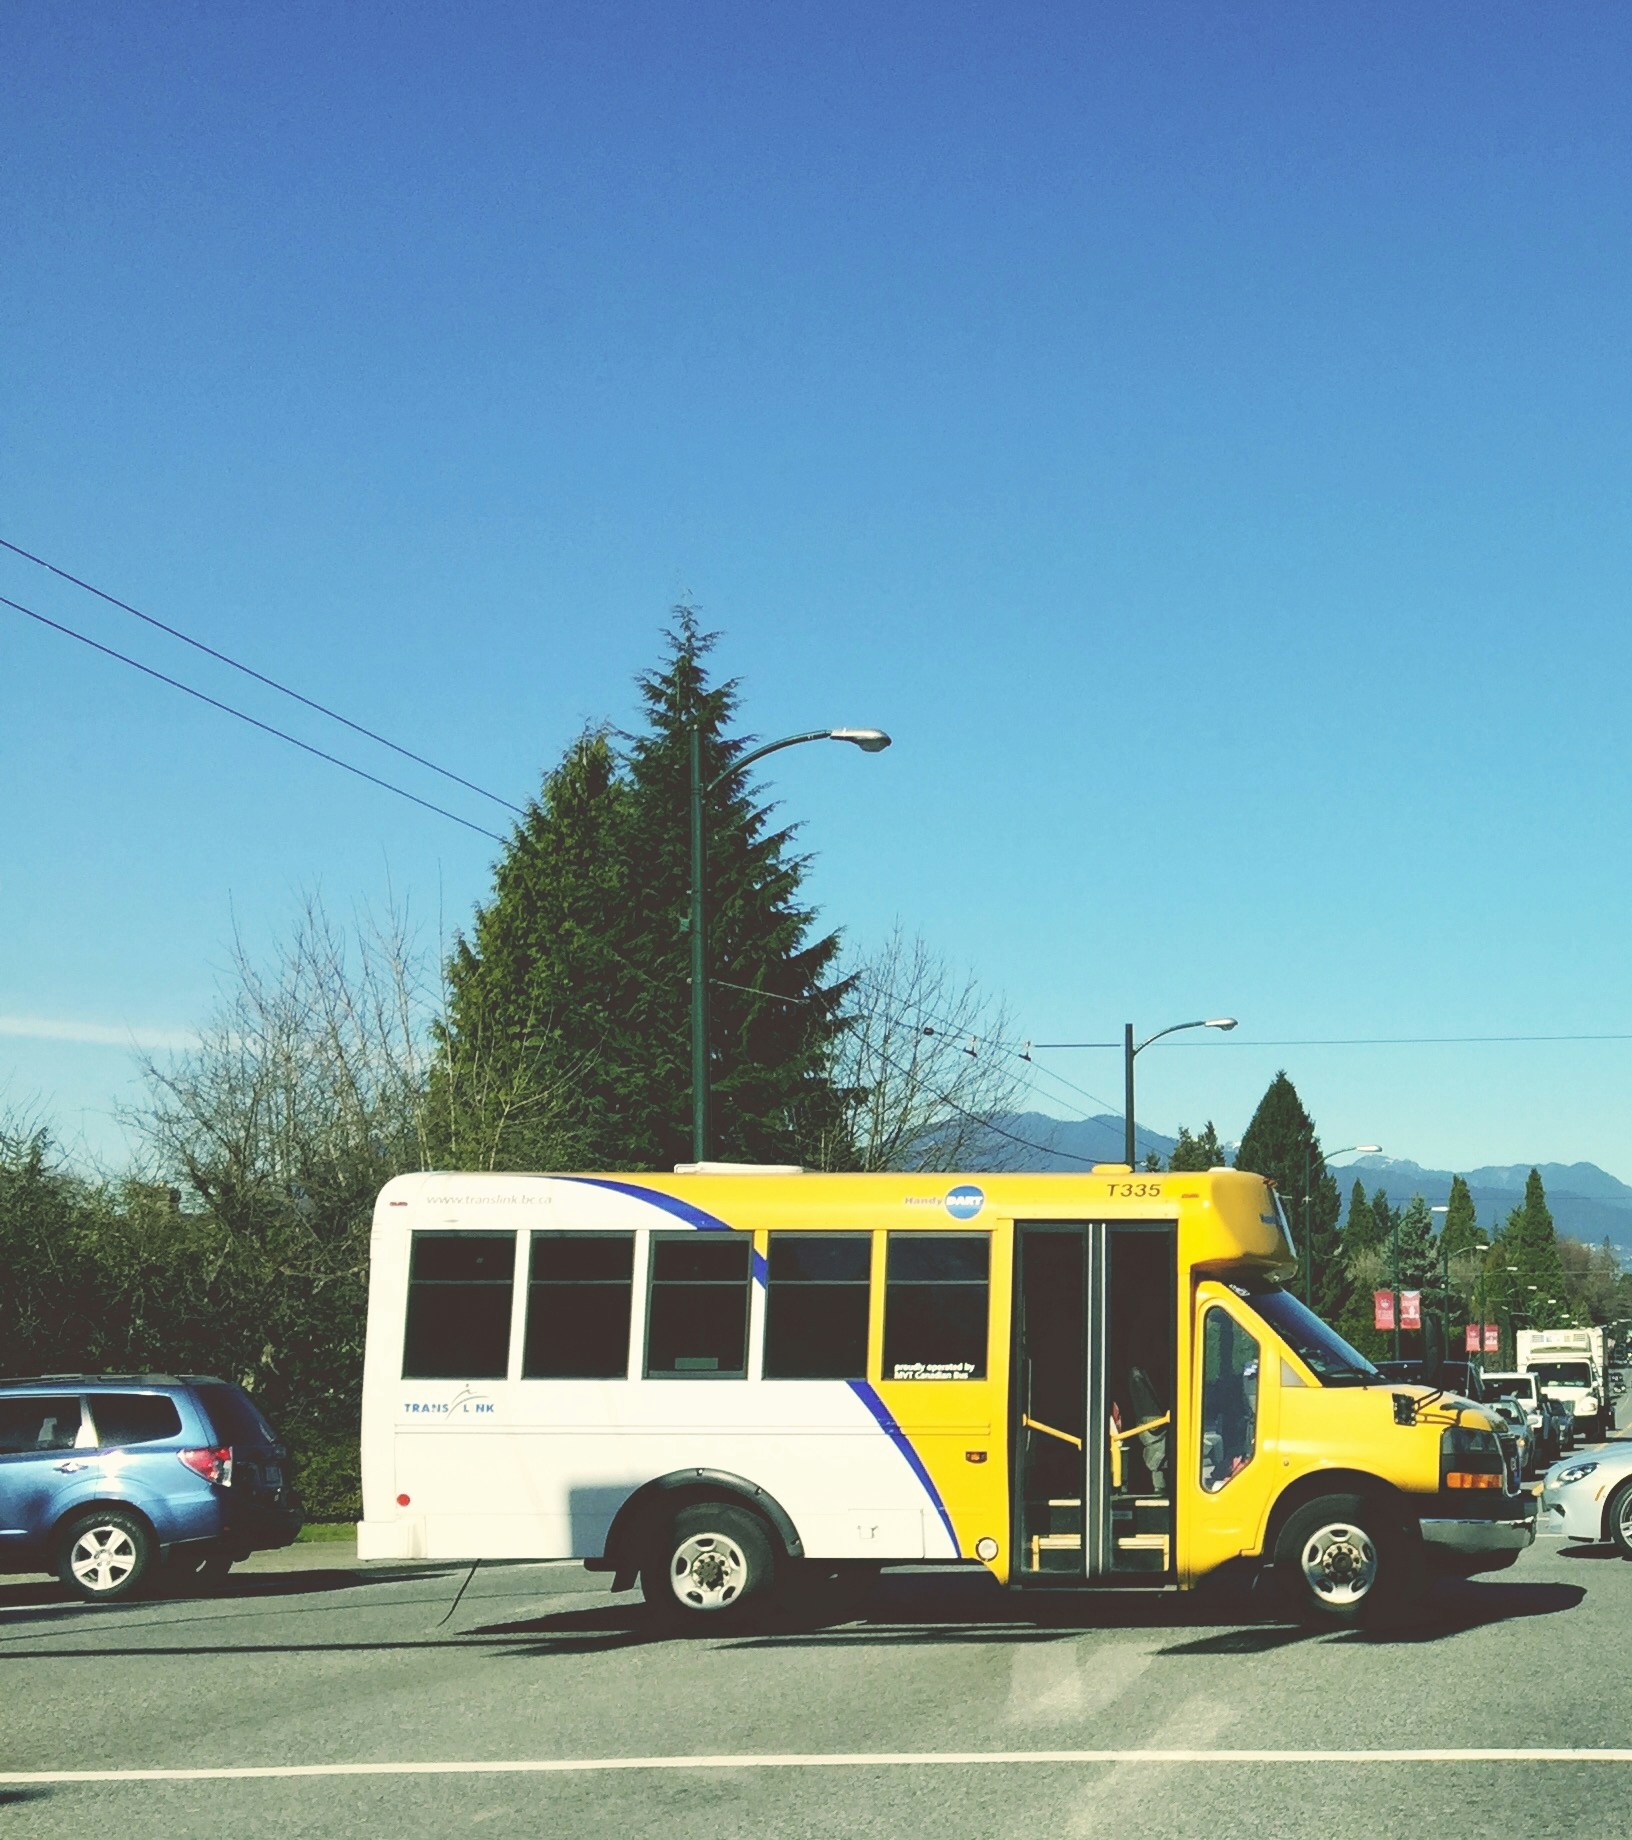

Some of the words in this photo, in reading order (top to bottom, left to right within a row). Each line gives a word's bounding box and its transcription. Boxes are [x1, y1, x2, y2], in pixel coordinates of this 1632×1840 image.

[1107, 1183, 1161, 1197] T335
[894, 1362, 926, 1372] proudly
[926, 1362, 964, 1372] operated
[964, 1362, 975, 1373] by
[953, 1371, 969, 1379] Bus
